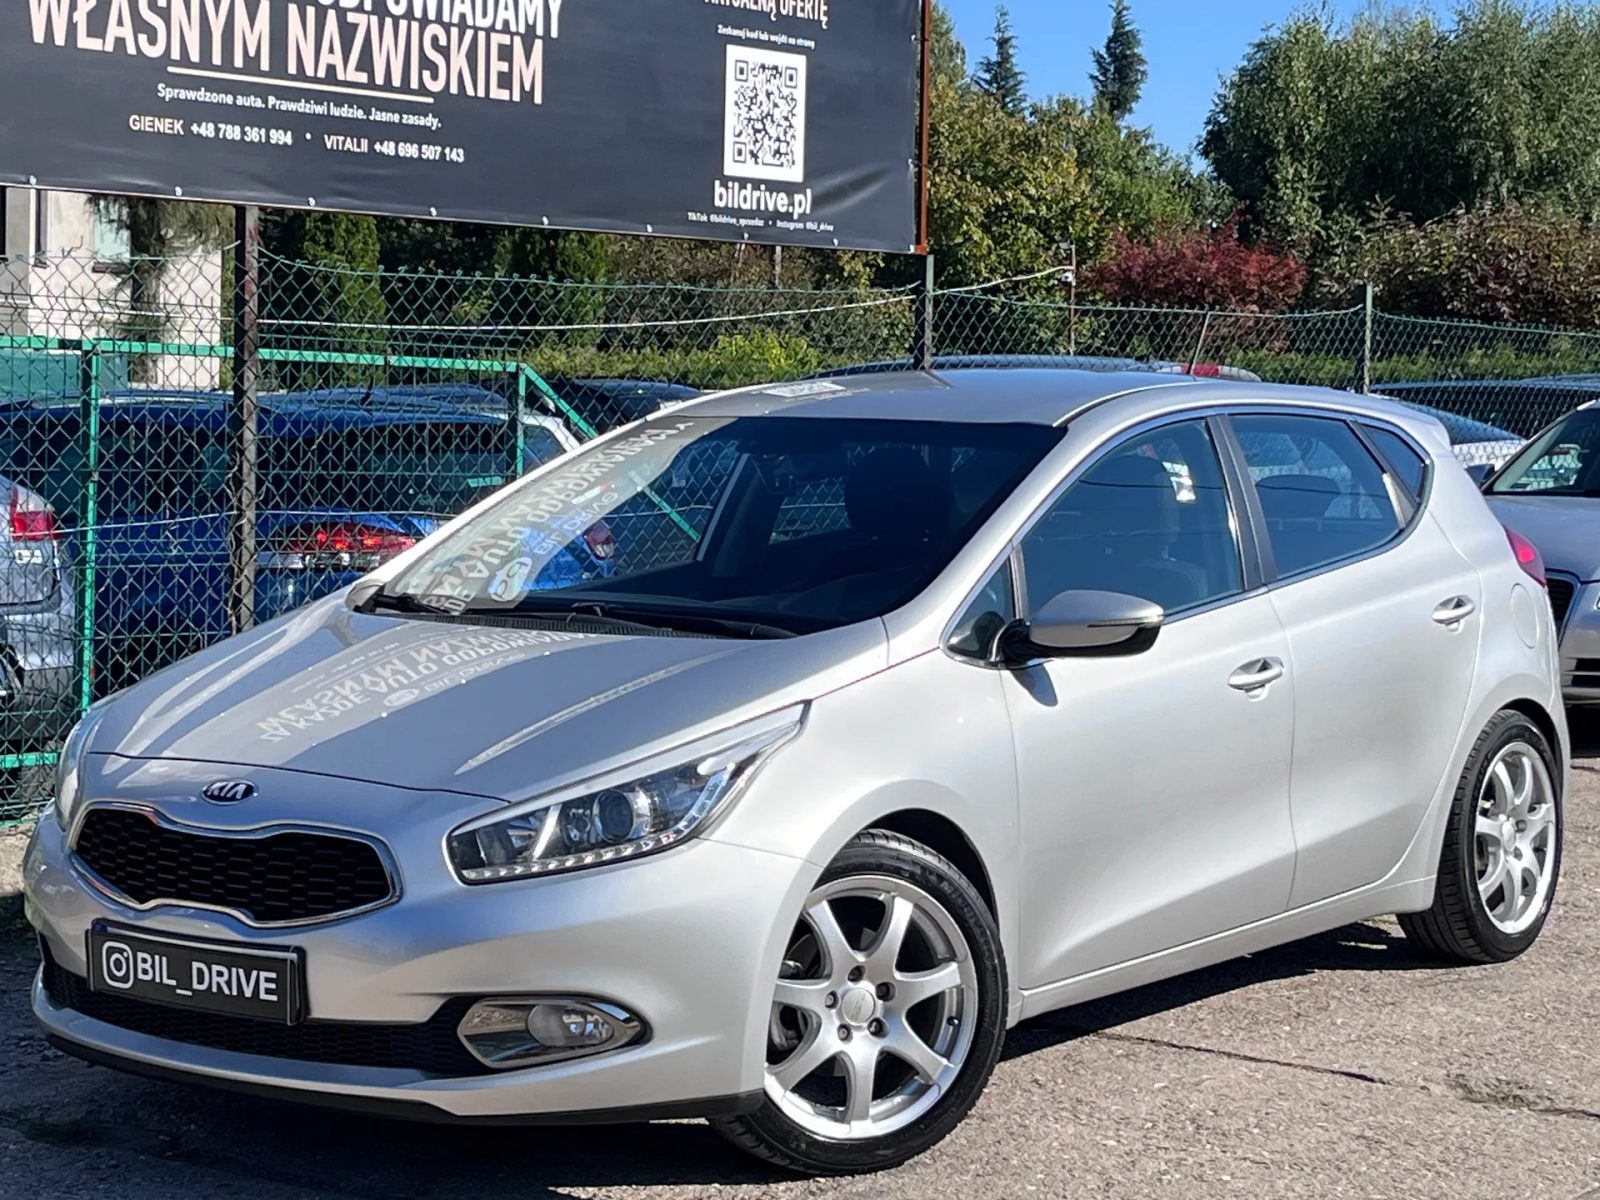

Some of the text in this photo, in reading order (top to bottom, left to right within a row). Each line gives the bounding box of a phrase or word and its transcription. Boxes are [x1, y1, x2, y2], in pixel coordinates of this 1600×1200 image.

[28, 0, 544, 104] WŁASNYM NAZWISKIEM
[157, 83, 442, 131] Sprawdzone auta. Prawdziwi ludzie. Jasne zasady.
[128, 114, 465, 163] GIENEK +48 788 361 994 VITALII +48 696 507 143
[714, 179, 812, 220] bildrive.pl
[206, 782, 247, 799] KIA
[136, 951, 279, 1002] BIL_DRIVE
